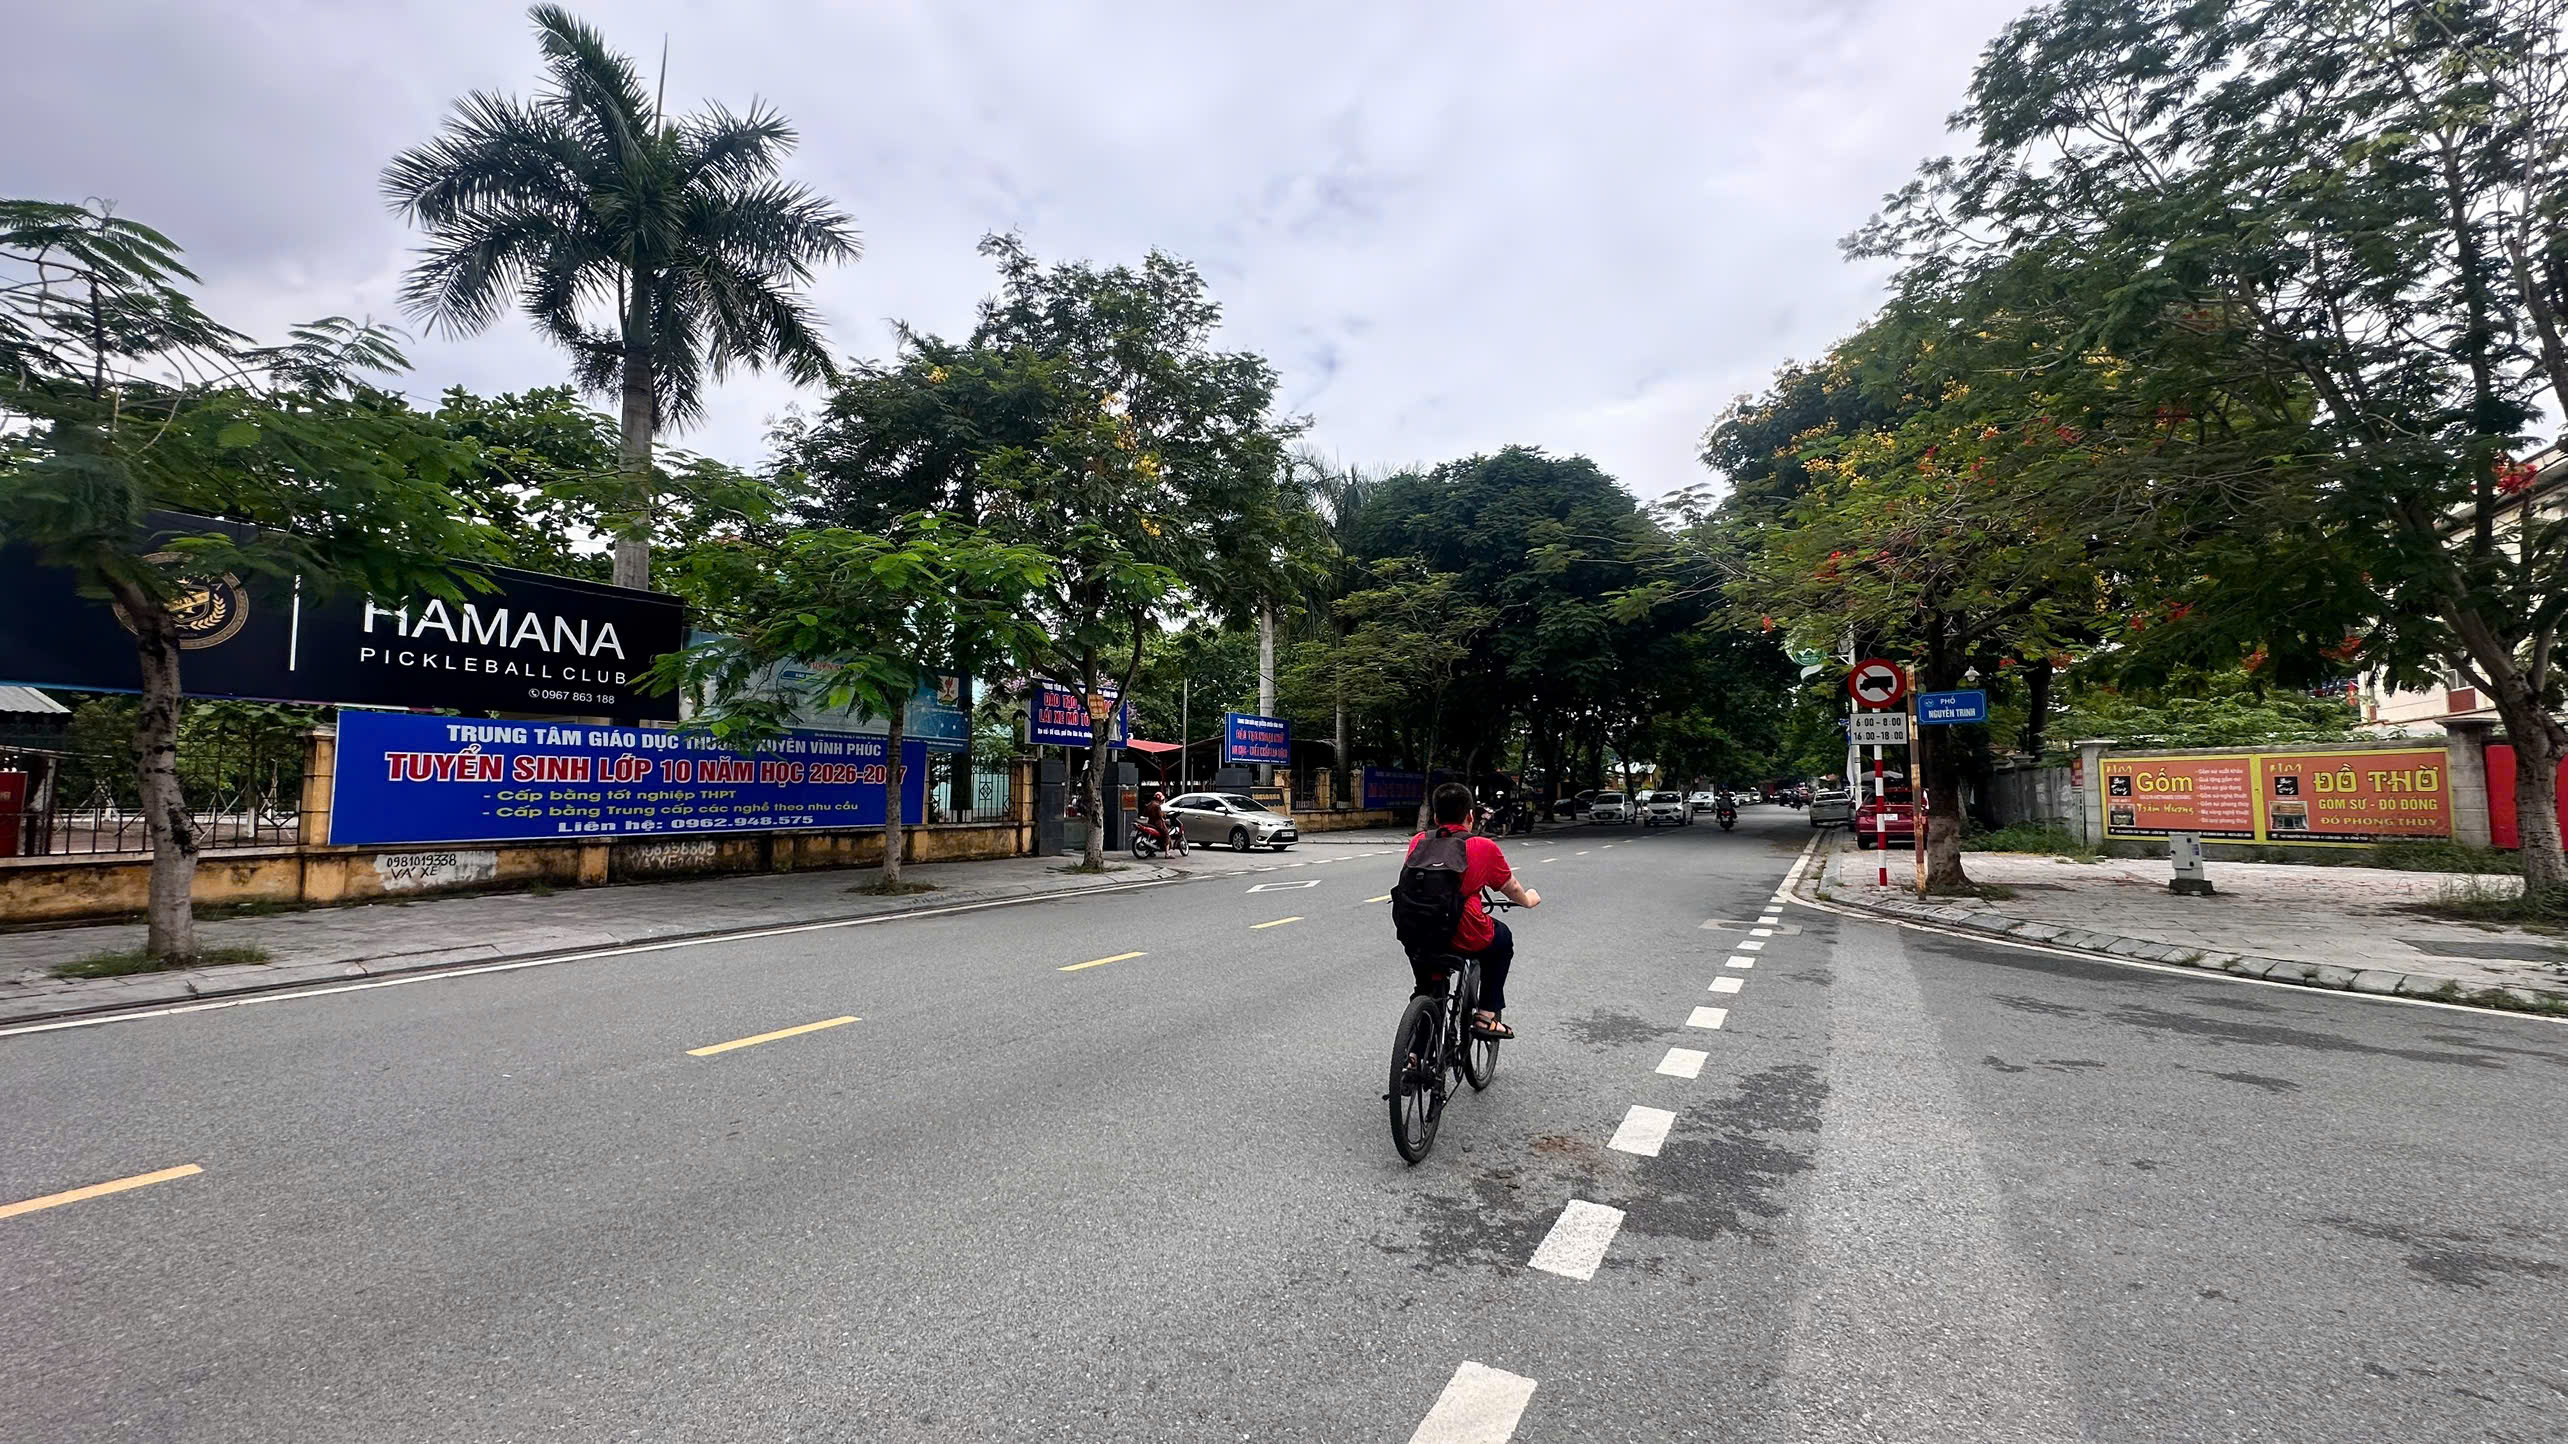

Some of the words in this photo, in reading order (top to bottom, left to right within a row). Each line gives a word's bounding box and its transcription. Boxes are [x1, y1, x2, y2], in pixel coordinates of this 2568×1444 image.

[364, 593, 625, 660] HAMANA
[360, 647, 552, 679] PICKLEBALL
[563, 667, 626, 685] CLUB
[541, 689, 569, 700] 0967
[572, 692, 593, 703] 863
[596, 694, 615, 704] 188
[1940, 695, 1956, 705] PHỐ
[1038, 707, 1053, 723] LÁI
[1053, 710, 1065, 724] XE
[447, 724, 527, 745] TRUNG
[534, 726, 582, 746] TÂM
[589, 728, 636, 748] GIÁO
[641, 733, 679, 752] DỤC
[757, 736, 806, 754] XUYÊN
[810, 740, 843, 755] VĨNH
[847, 741, 882, 757] PHÚC
[385, 743, 504, 783] TUYỂN
[512, 755, 590, 783] SINH
[598, 753, 653, 783] LỚP
[660, 758, 693, 783] 10
[698, 756, 754, 783] NĂM
[759, 762, 805, 787] HỌC
[809, 763, 908, 784] 2026-207
[2136, 768, 2193, 792] Gốm
[2313, 762, 2358, 793] ĐỒ
[2367, 764, 2440, 793] THỜ
[497, 789, 543, 802] Cấp
[550, 789, 601, 802] bằng
[607, 789, 632, 800] tốt
[637, 790, 696, 802] nghiệp
[700, 790, 737, 799] THPT
[496, 805, 543, 818] Cấp
[549, 804, 601, 818] bằng
[606, 805, 655, 817] Trung
[660, 803, 694, 815] cấp
[699, 804, 729, 813] các
[733, 802, 770, 814] nghề
[774, 803, 804, 811] theo
[808, 802, 832, 811] nhu
[835, 801, 858, 810] cầu
[558, 821, 617, 832] Liên
[625, 820, 663, 831] hệ:
[671, 815, 814, 829] 0962.948.575
[2343, 817, 2394, 826] PHONG
[386, 853, 457, 867] 0981019338
[420, 865, 438, 878] XE
